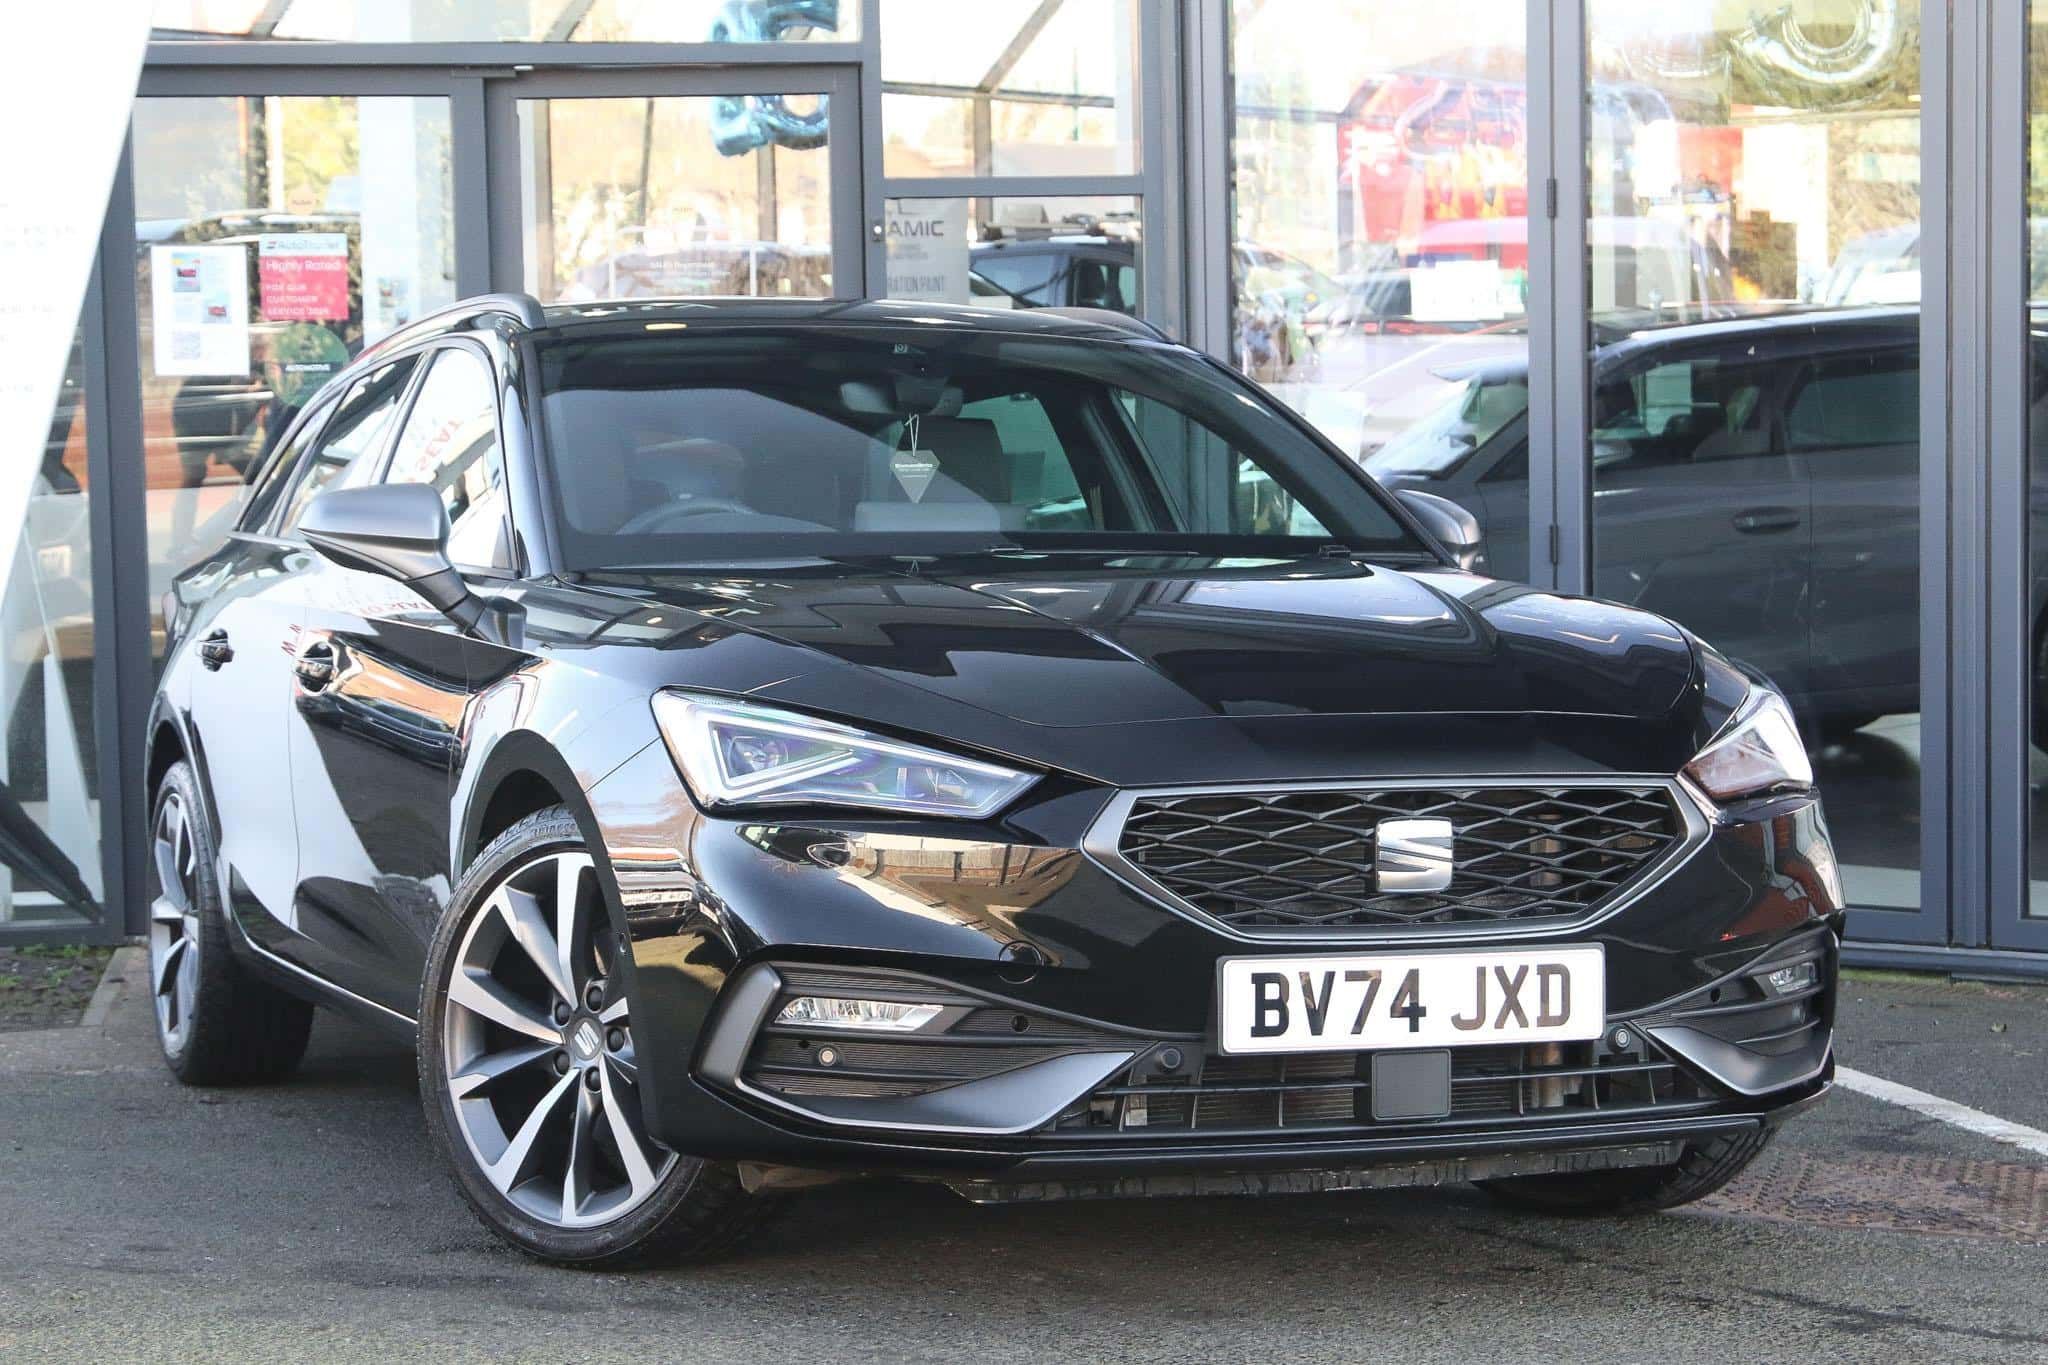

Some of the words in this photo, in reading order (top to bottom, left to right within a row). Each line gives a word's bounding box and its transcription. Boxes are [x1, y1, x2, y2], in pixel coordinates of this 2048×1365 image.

[887, 220, 945, 237] AMIC
[266, 260, 302, 272] Highly
[1250, 968, 1427, 1038] BV74
[1450, 963, 1571, 1031] JXD
